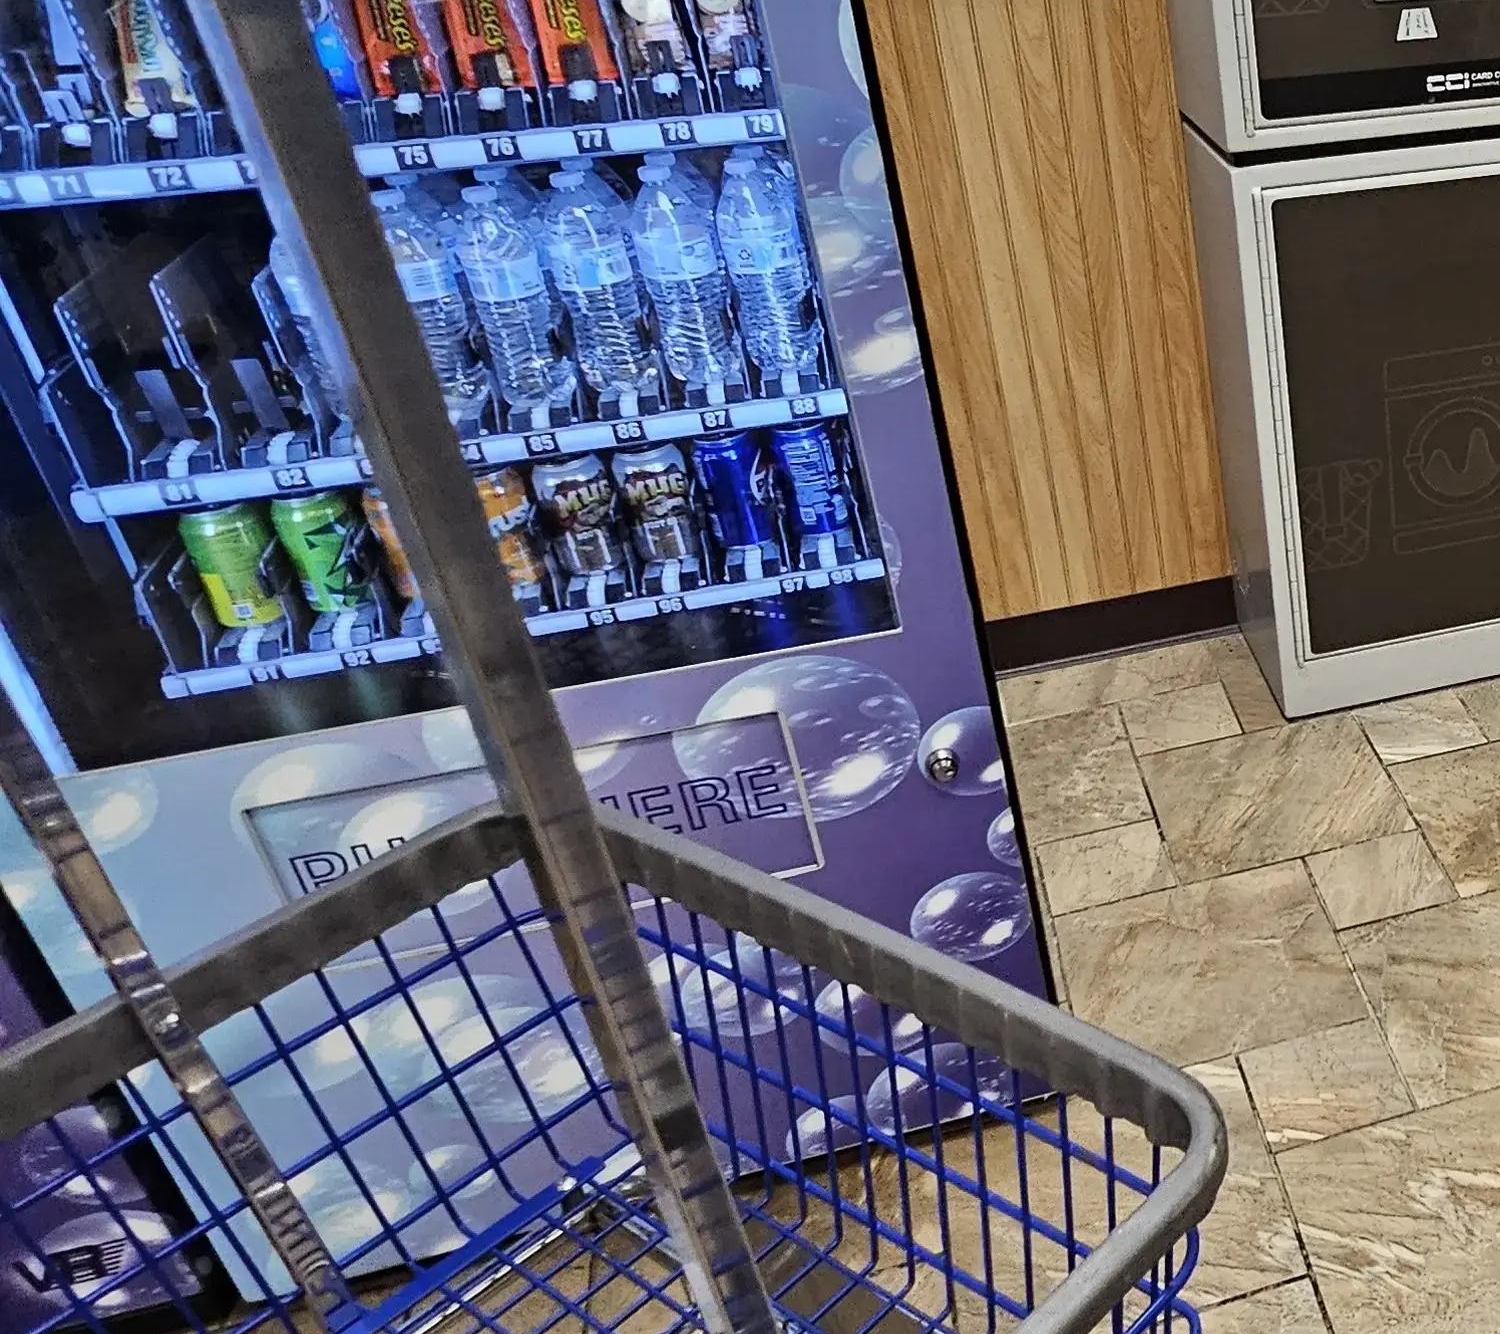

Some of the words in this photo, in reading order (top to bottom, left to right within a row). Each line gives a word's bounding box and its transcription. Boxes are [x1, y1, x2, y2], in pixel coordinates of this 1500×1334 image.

[1471, 71, 1493, 80] CARD
[51, 174, 82, 196] 71
[152, 167, 187, 188] 72
[399, 145, 429, 166] 75
[485, 138, 515, 158] 76
[577, 129, 603, 149] 77
[663, 121, 693, 142] 78
[748, 114, 774, 135] 79
[165, 484, 195, 504] 81
[275, 469, 306, 487] 82
[528, 436, 556, 453] 85
[615, 422, 642, 440] 86
[702, 410, 728, 428] 87
[791, 398, 818, 415] 88
[625, 472, 687, 503] MUG
[253, 666, 278, 682] 91
[344, 650, 371, 667] 92
[589, 609, 615, 626] 95
[658, 598, 683, 614] 96
[781, 576, 804, 593] 97
[829, 569, 853, 584] 98
[601, 764, 788, 836] ERE
